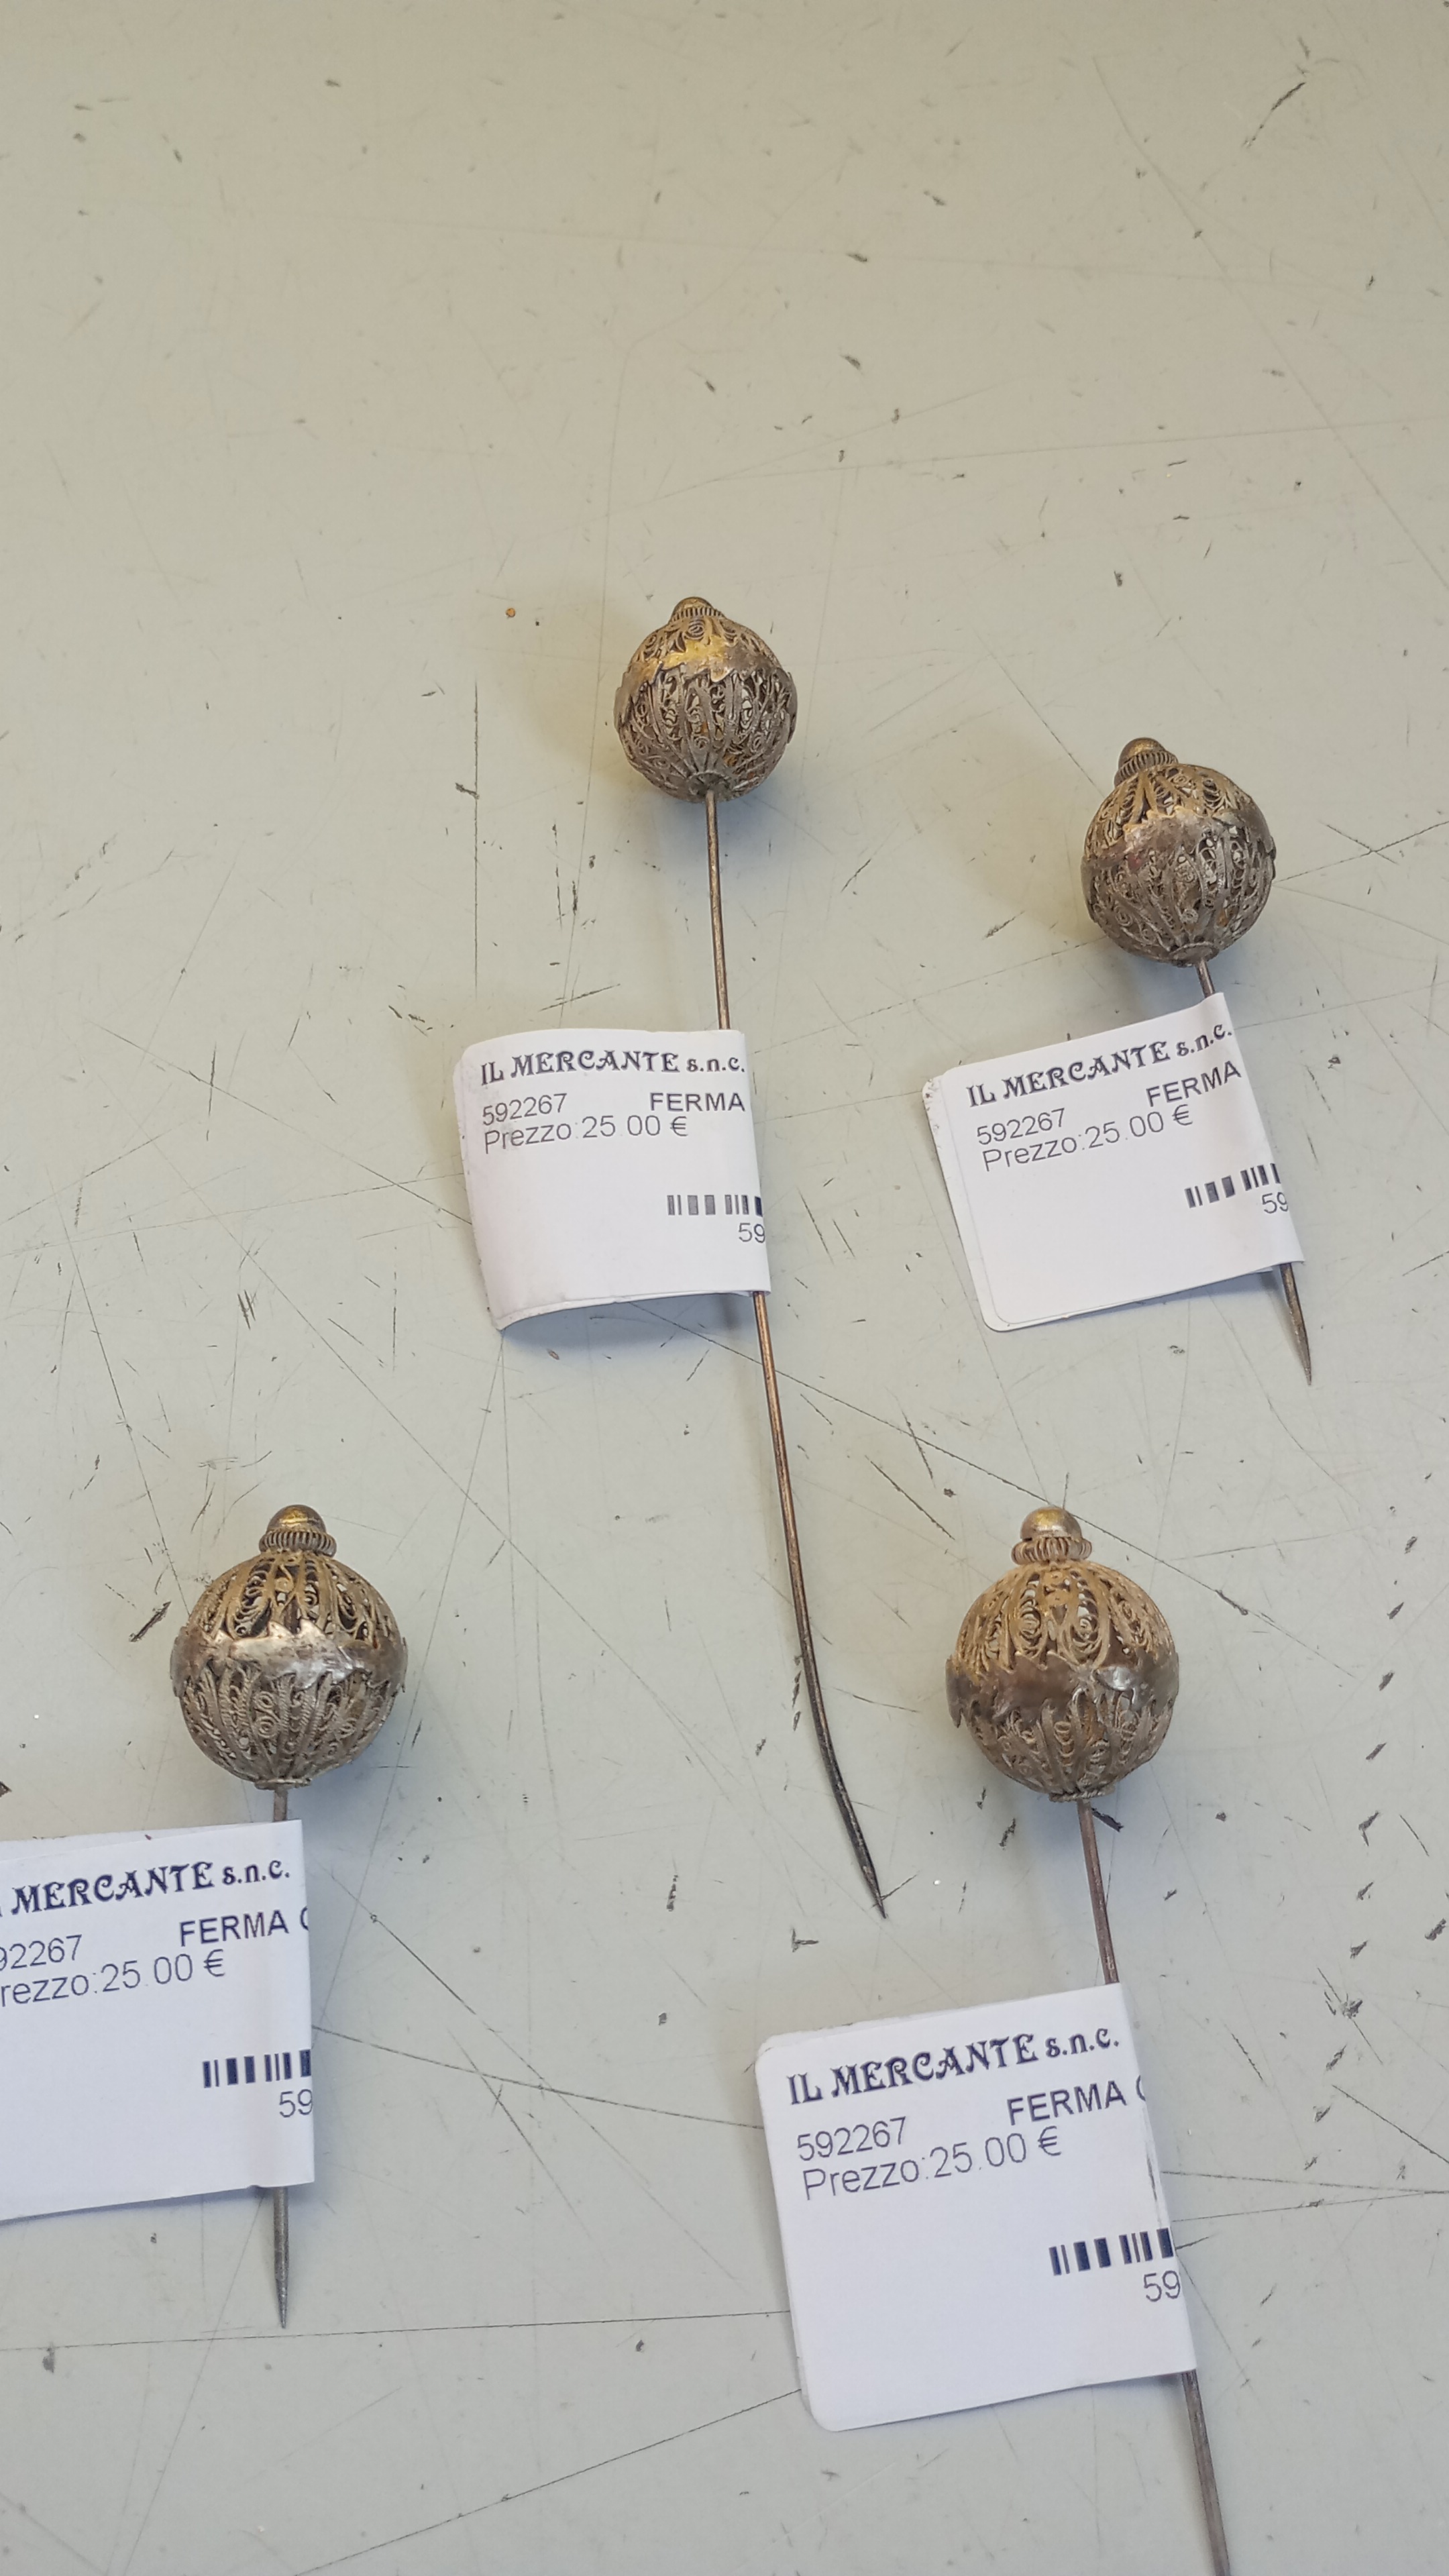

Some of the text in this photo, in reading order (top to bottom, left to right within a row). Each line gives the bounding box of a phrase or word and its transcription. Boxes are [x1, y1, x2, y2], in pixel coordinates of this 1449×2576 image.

[481, 1051, 745, 1085] IL MERCANTE s.n.c.
[966, 1024, 1233, 1108] IL MERCANTE s.n.c.
[1146, 1060, 1242, 1107] FERMA
[482, 1093, 568, 1126] 592267
[649, 1092, 745, 1112] FERMA
[1173, 1104, 1193, 1126] €
[669, 1116, 688, 1137] €
[977, 1108, 1065, 1146] 592267
[1261, 1193, 1289, 1214] 59
[738, 1223, 765, 1243] 59
[11, 1860, 290, 1916] MERCANTE s.n.c.
[180, 1910, 289, 1946] FERMA
[0, 1949, 225, 2007] rezzo:25.00 €
[787, 2027, 1119, 2105] IL MERCANTE s.n.c.
[279, 2089, 313, 2118] 59
[1006, 2079, 1127, 2126] FERMA
[797, 2116, 907, 2161] 592267
[1038, 2126, 1061, 2157] €
[1143, 2270, 1181, 2302] 59
